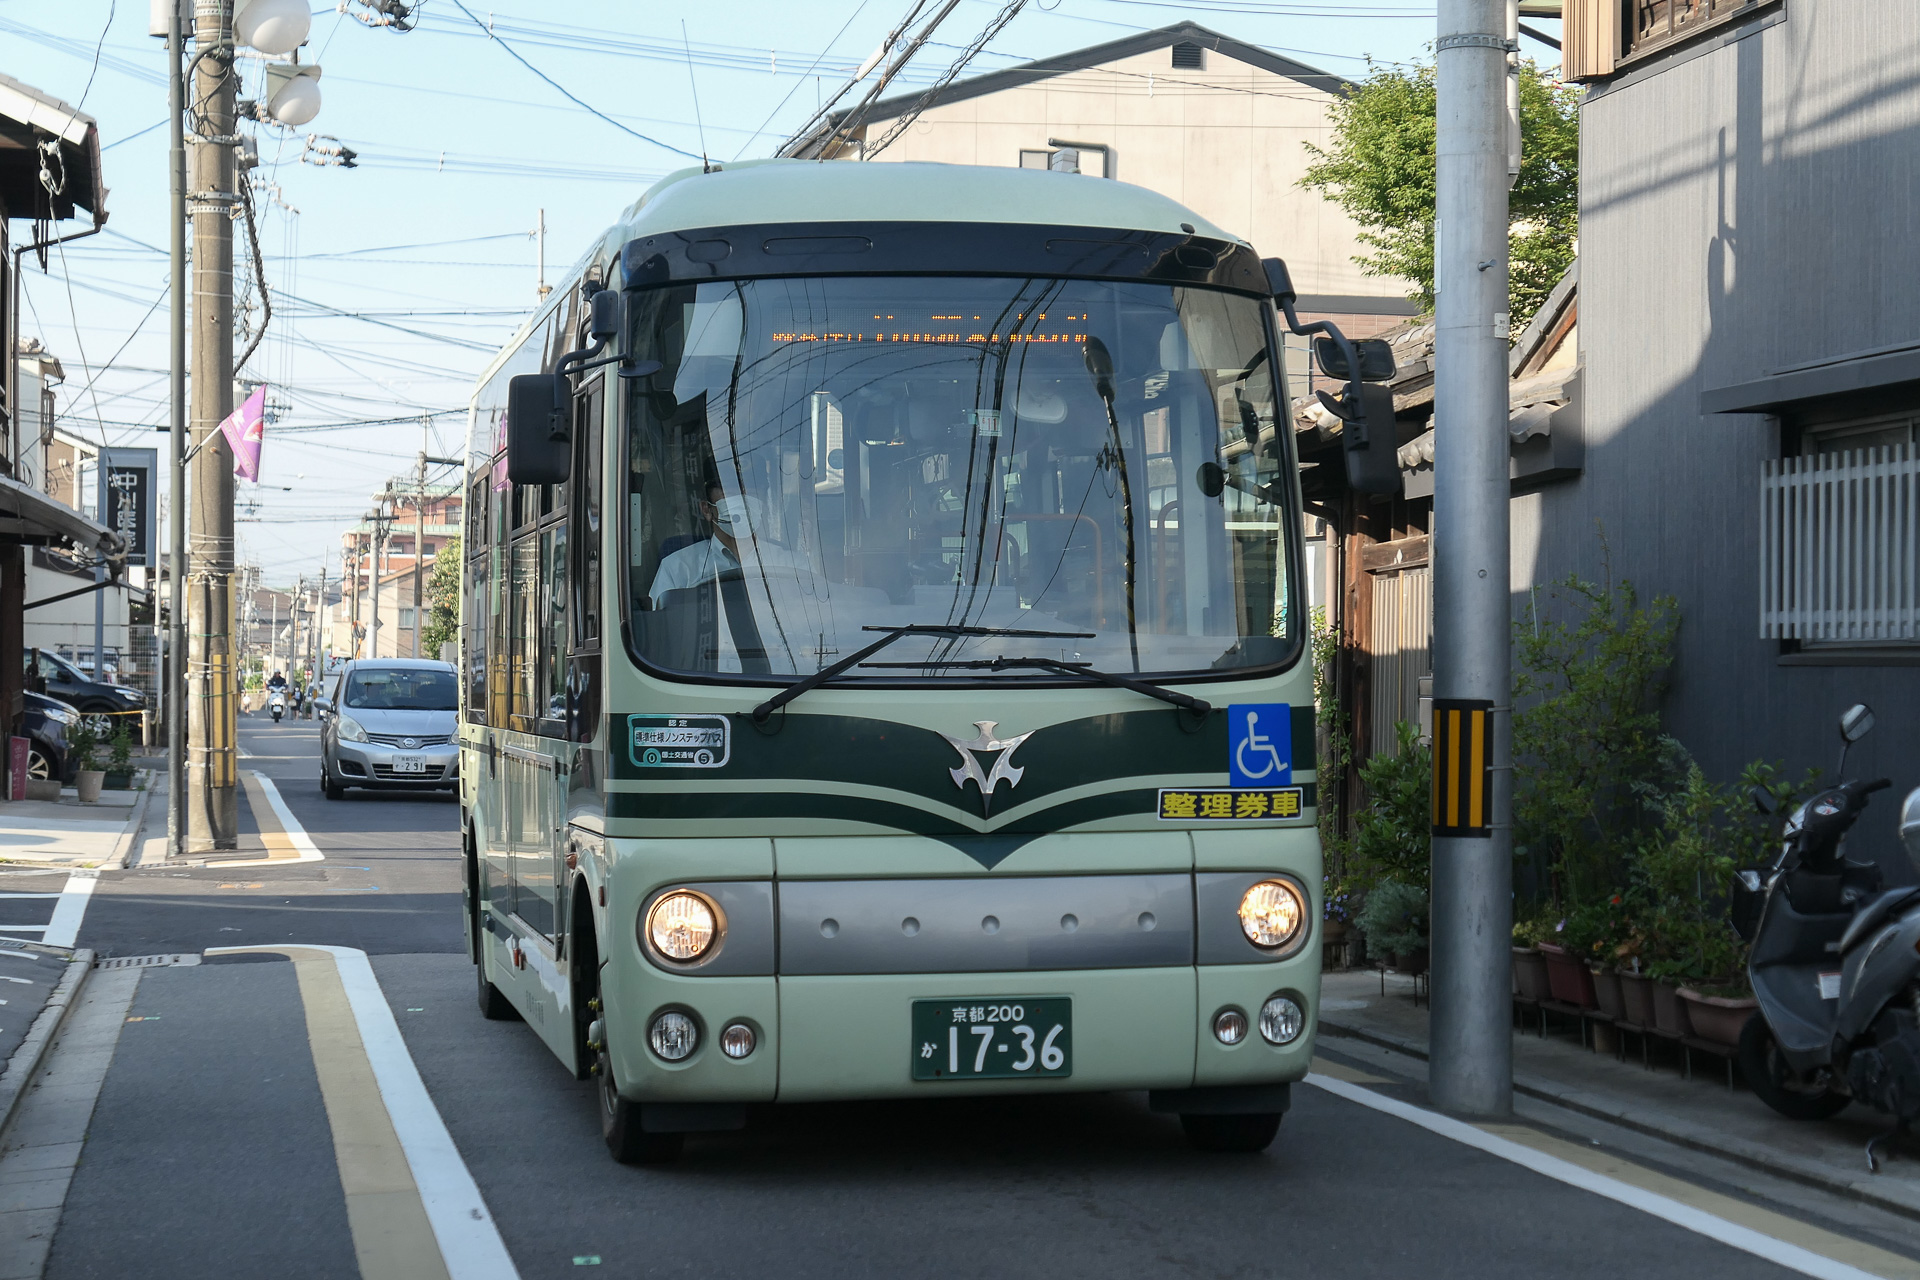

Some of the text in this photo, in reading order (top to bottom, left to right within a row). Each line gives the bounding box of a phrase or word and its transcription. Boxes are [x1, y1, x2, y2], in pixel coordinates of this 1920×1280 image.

[668, 719, 688, 727] 認定
[635, 731, 722, 743] 標準仕様ノンステップバス
[661, 751, 694, 759] 国土交通省
[1162, 792, 1299, 818] 整理券車
[951, 1005, 1025, 1023] 京都200
[920, 1024, 1065, 1073] か 17-36
